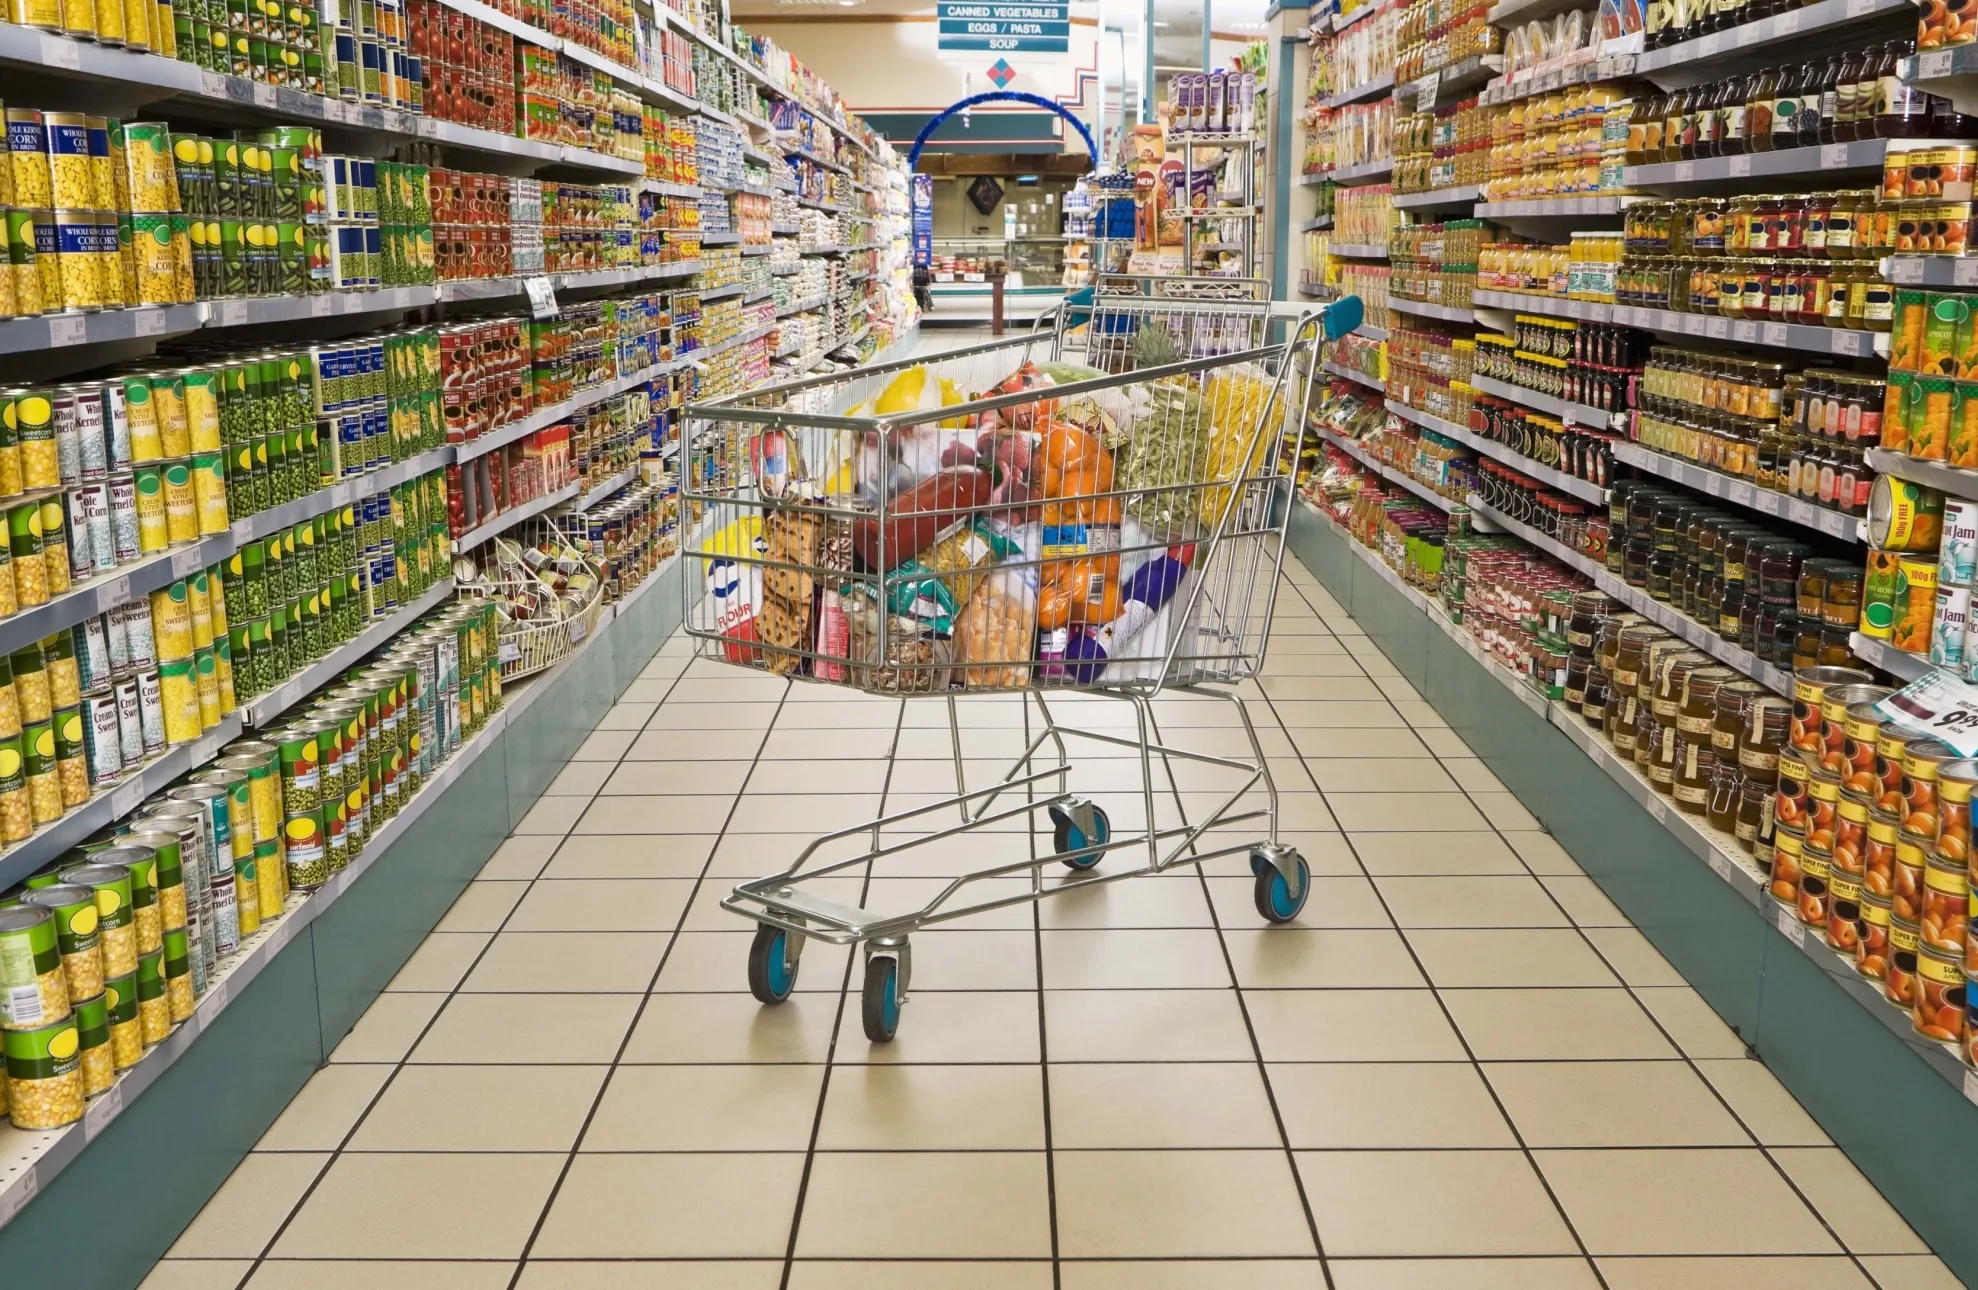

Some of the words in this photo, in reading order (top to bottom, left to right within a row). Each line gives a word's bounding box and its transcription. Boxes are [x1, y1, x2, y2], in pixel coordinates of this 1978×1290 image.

[948, 6, 990, 16] CANNED
[994, 8, 1058, 18] VEGETABLES
[968, 23, 997, 33] EGGS
[1001, 24, 1007, 34] /
[1010, 24, 1042, 34] PASTA
[990, 40, 1018, 49] SOUP
[8, 135, 37, 144] CORN
[1136, 176, 1154, 185] NEW
[54, 410, 74, 421] Whole
[76, 417, 100, 427] Kernel
[113, 488, 133, 498] Whole
[84, 496, 96, 506] ole
[89, 507, 107, 517] Corn
[1899, 503, 1908, 519] FREE
[1953, 528, 1975, 539] Jam
[1911, 570, 1928, 581] 100g
[717, 603, 751, 628] FLOUR
[1943, 608, 1965, 622] Jam
[94, 710, 114, 723] Cream
[1948, 726, 1965, 734] EACH
[1792, 764, 1804, 772] FINE
[1803, 857, 1815, 866] SUPER
[1834, 881, 1851, 890] SUPER
[212, 887, 232, 898] Whole
[1834, 887, 1853, 897] APRICOT
[1894, 929, 1911, 940] SUPER
